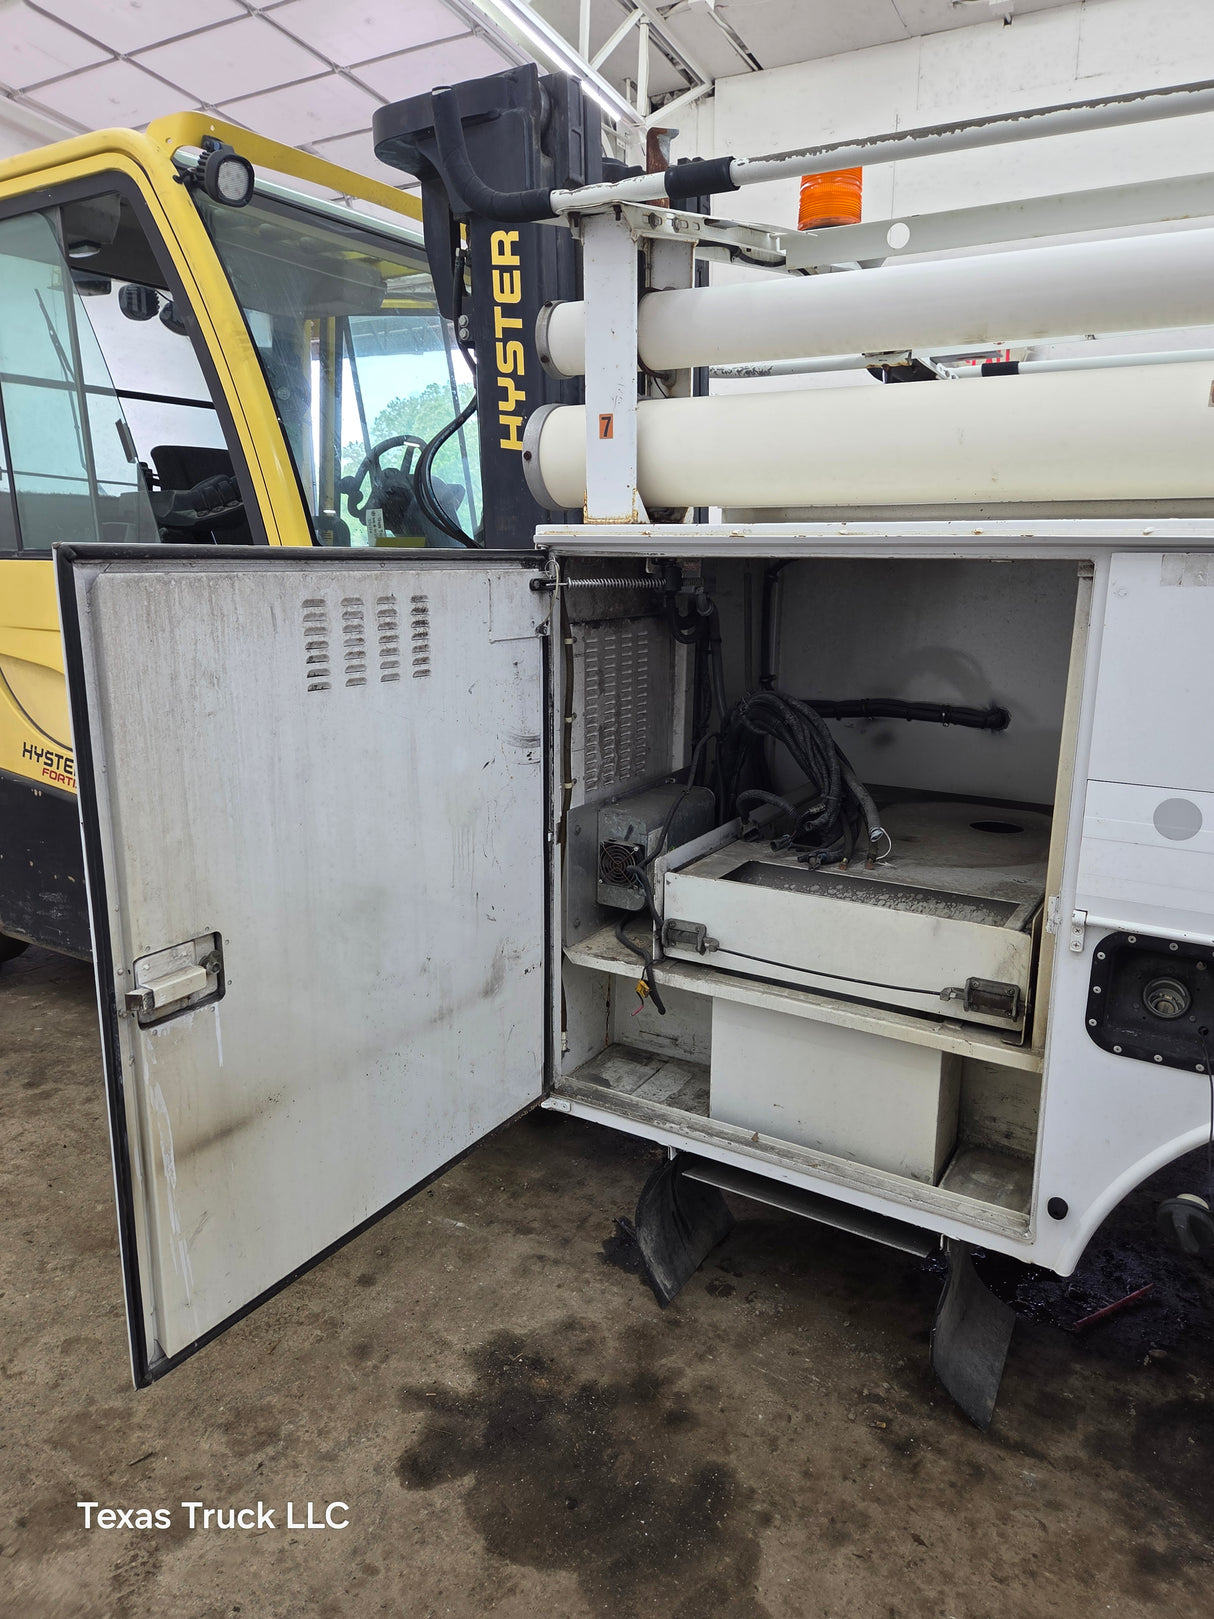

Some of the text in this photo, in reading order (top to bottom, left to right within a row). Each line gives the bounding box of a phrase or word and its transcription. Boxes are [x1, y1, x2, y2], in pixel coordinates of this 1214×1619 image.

[490, 230, 526, 450] HYSTER
[601, 416, 612, 438] 7
[22, 741, 75, 777] HYSTE
[41, 767, 77, 788] FORTI
